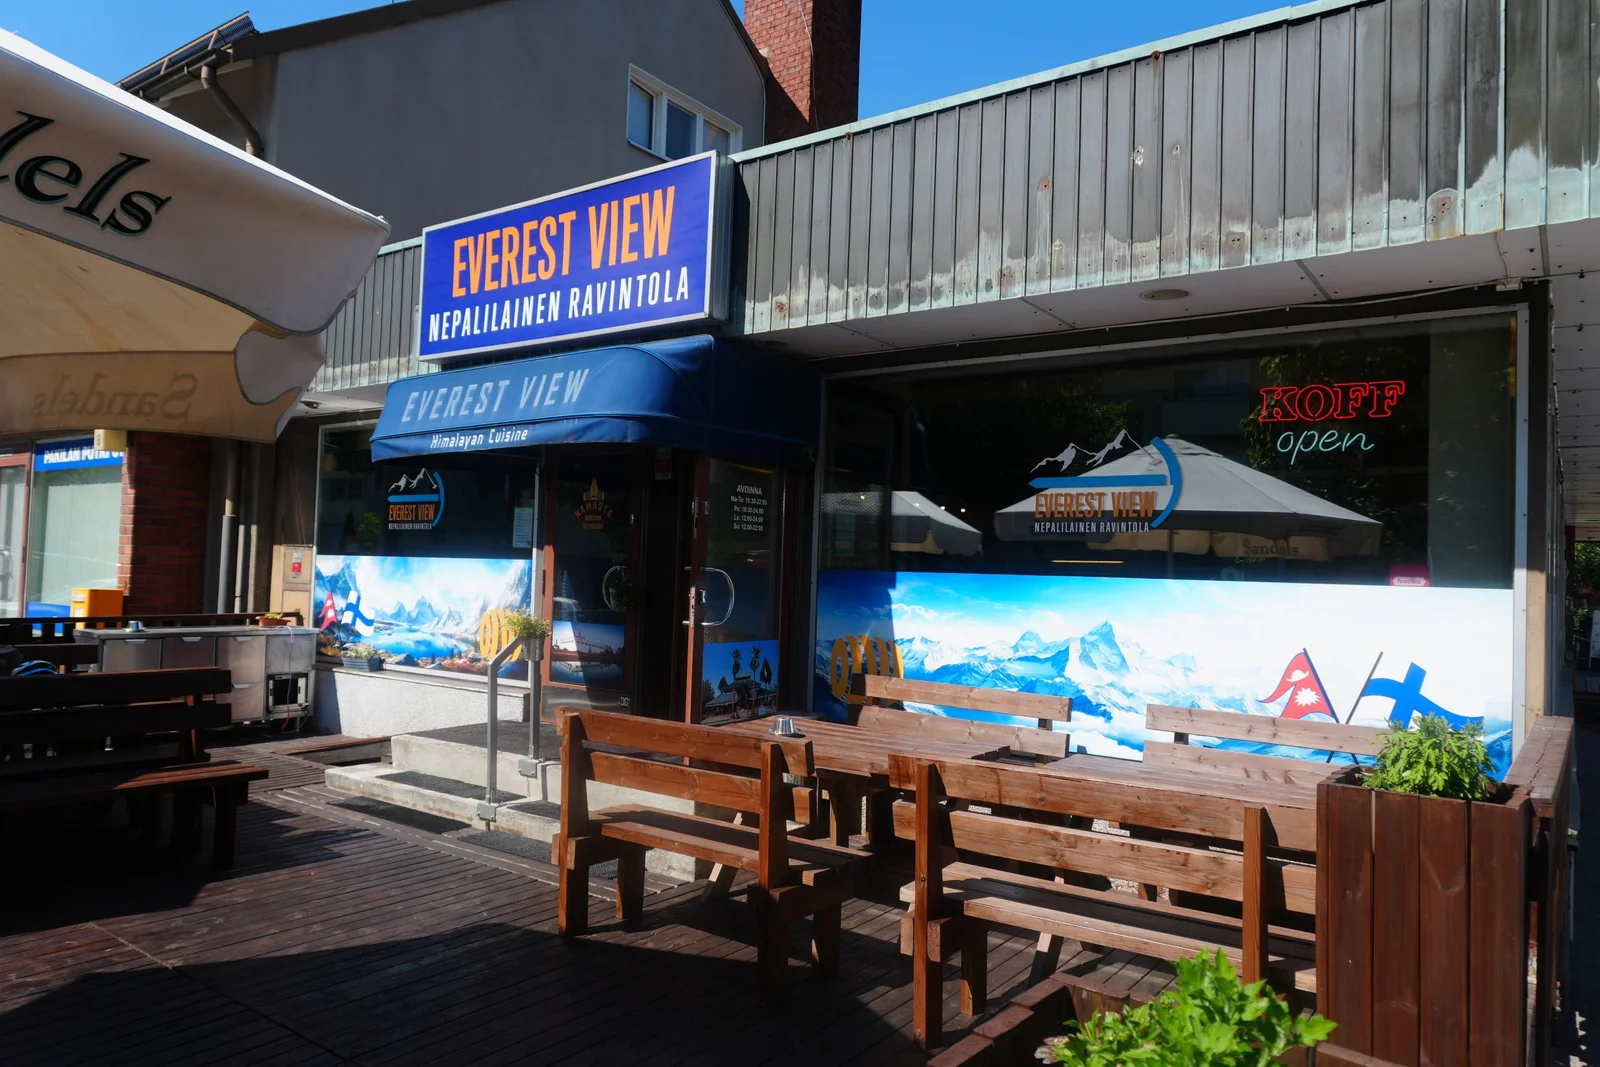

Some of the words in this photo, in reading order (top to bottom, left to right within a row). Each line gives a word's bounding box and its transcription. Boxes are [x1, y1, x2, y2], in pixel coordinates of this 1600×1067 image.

[452, 211, 577, 298] EVEREST
[588, 185, 676, 270] VIEW
[428, 290, 561, 342] NEPALILAINEN
[567, 266, 690, 319] RAVINTOLA
[401, 379, 510, 422] EVEREST
[519, 368, 590, 408] VIEW
[1258, 380, 1405, 422] KOFF
[430, 434, 484, 450] Himalayan
[488, 429, 529, 444] Cuisine
[1277, 430, 1375, 465] open
[43, 447, 80, 464] PAKILAN
[736, 484, 763, 496] AVOINNA
[389, 504, 417, 521] EVEREST
[418, 504, 435, 521] VIEW
[1035, 492, 1106, 518] EVEREST
[1111, 491, 1157, 518] VIEW
[1034, 521, 1097, 533] NEPALILAINEN
[1099, 521, 1150, 533] RAVINTOLA
[1242, 538, 1300, 556] Sandels
